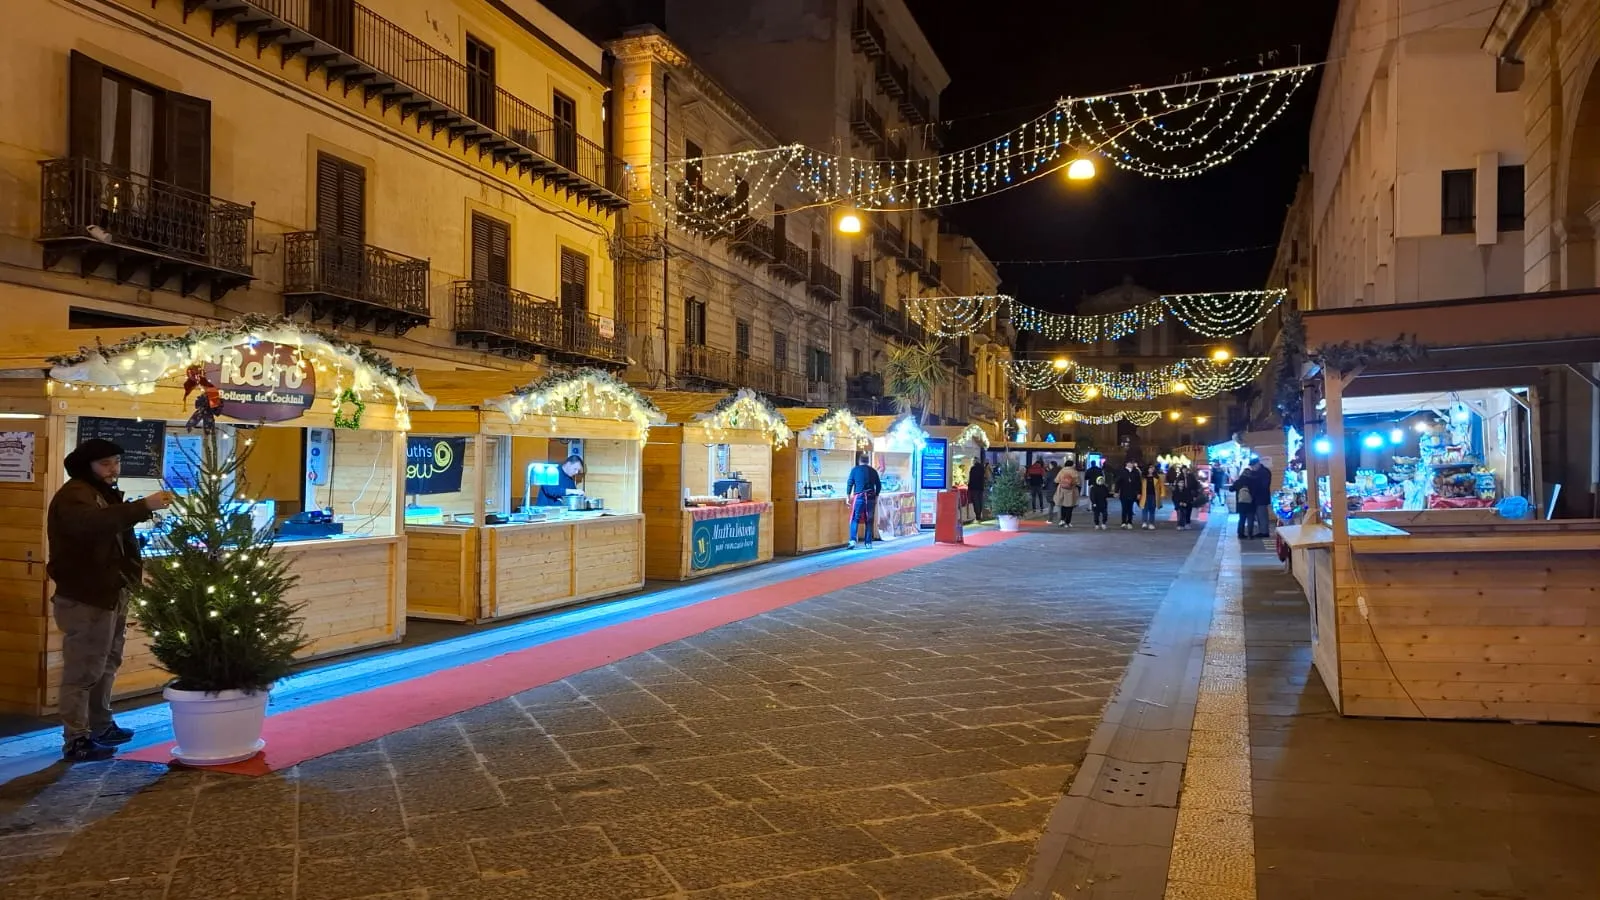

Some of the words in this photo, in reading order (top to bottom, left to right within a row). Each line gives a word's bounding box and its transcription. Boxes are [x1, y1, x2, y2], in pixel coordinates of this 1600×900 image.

[218, 389, 252, 403] Bottega
[254, 391, 268, 402] del
[270, 393, 304, 405] Cocktail
